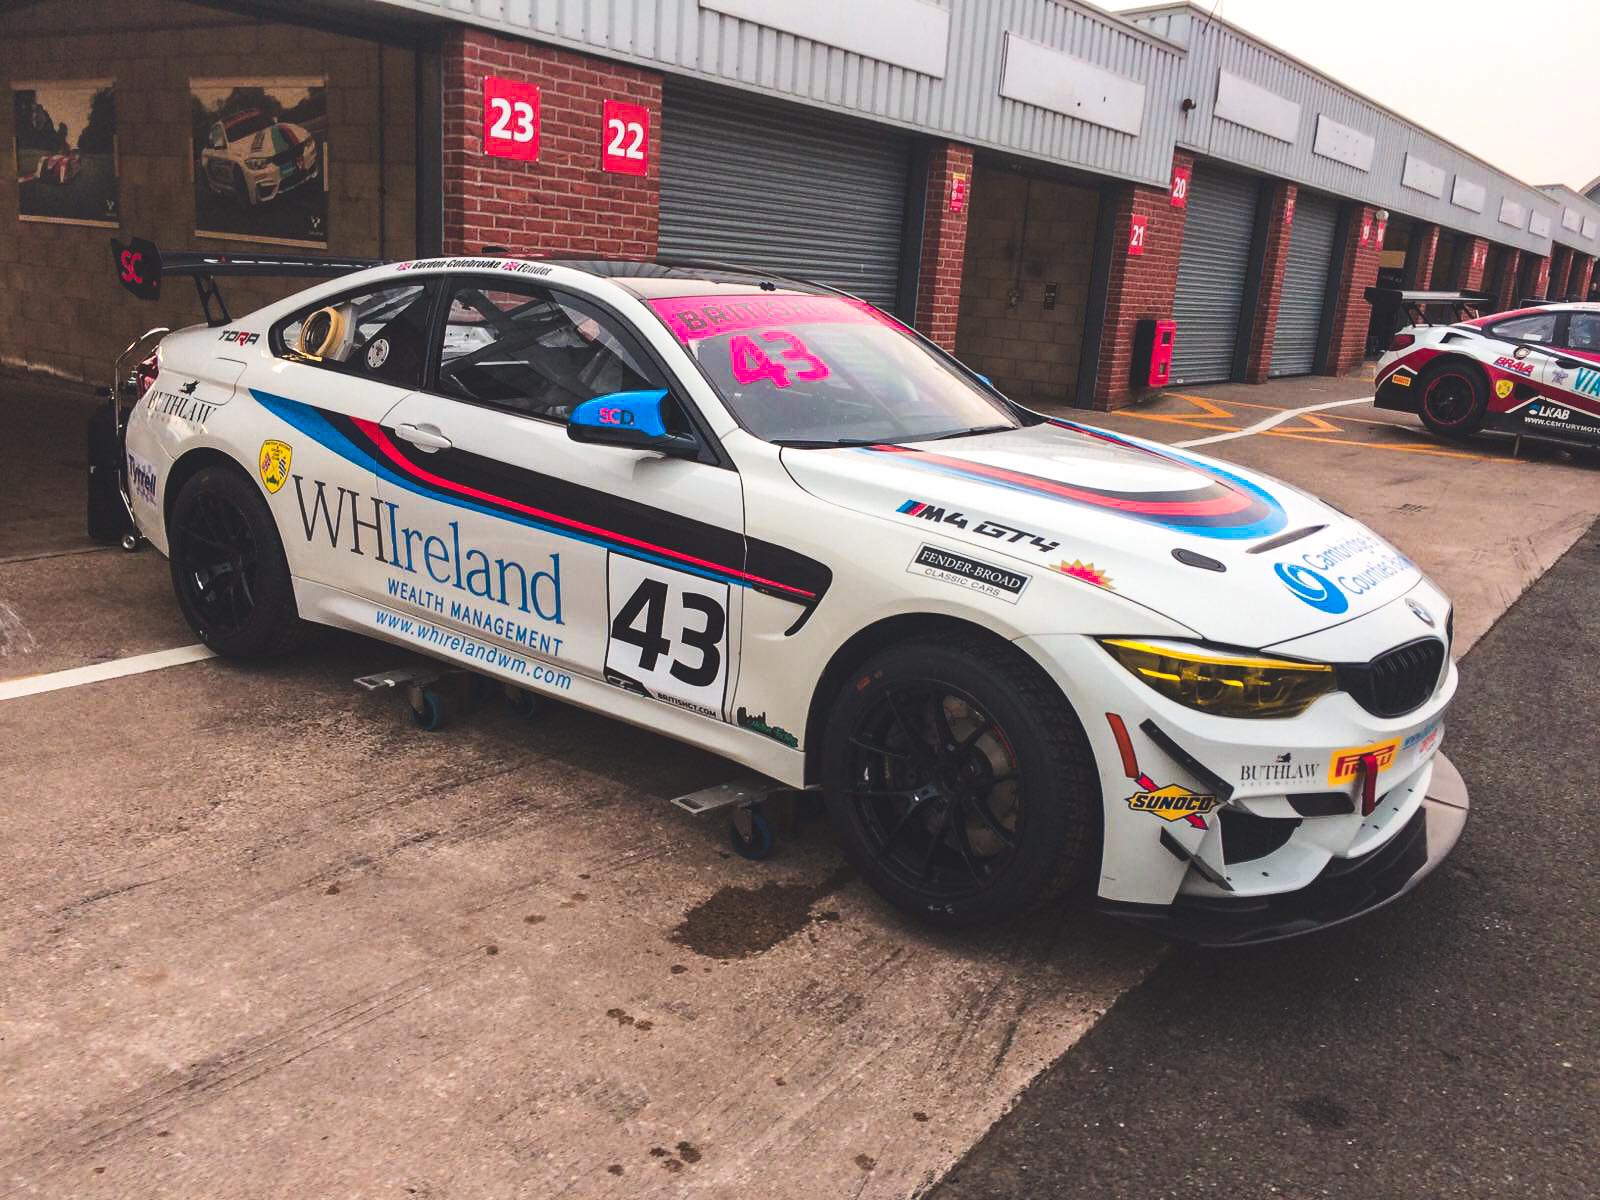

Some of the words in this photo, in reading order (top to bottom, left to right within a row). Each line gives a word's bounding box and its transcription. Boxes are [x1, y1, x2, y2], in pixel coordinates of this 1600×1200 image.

[490, 98, 534, 143] 23
[607, 119, 644, 160] 22
[1173, 177, 1186, 199] 20
[1131, 225, 1144, 246] 21
[517, 263, 551, 276] Fender
[729, 330, 832, 389] 43
[148, 391, 217, 424] BUTHLAW
[1539, 406, 1570, 420] LKAB
[916, 505, 968, 529] M4
[973, 521, 1060, 552] GT4
[920, 551, 1021, 590] FENDER-BROAD
[925, 568, 968, 585] CLASSIC
[970, 579, 1000, 596] CARS
[387, 577, 444, 614] WEALTH
[449, 603, 564, 657] MANAGEMENT
[610, 578, 725, 687] 43
[375, 610, 572, 690] www.whirelandwm.com
[657, 692, 717, 718] BRITISHGT.COM
[1240, 763, 1320, 781] BUTHLAW
[1133, 796, 1212, 811] SUNOCO
